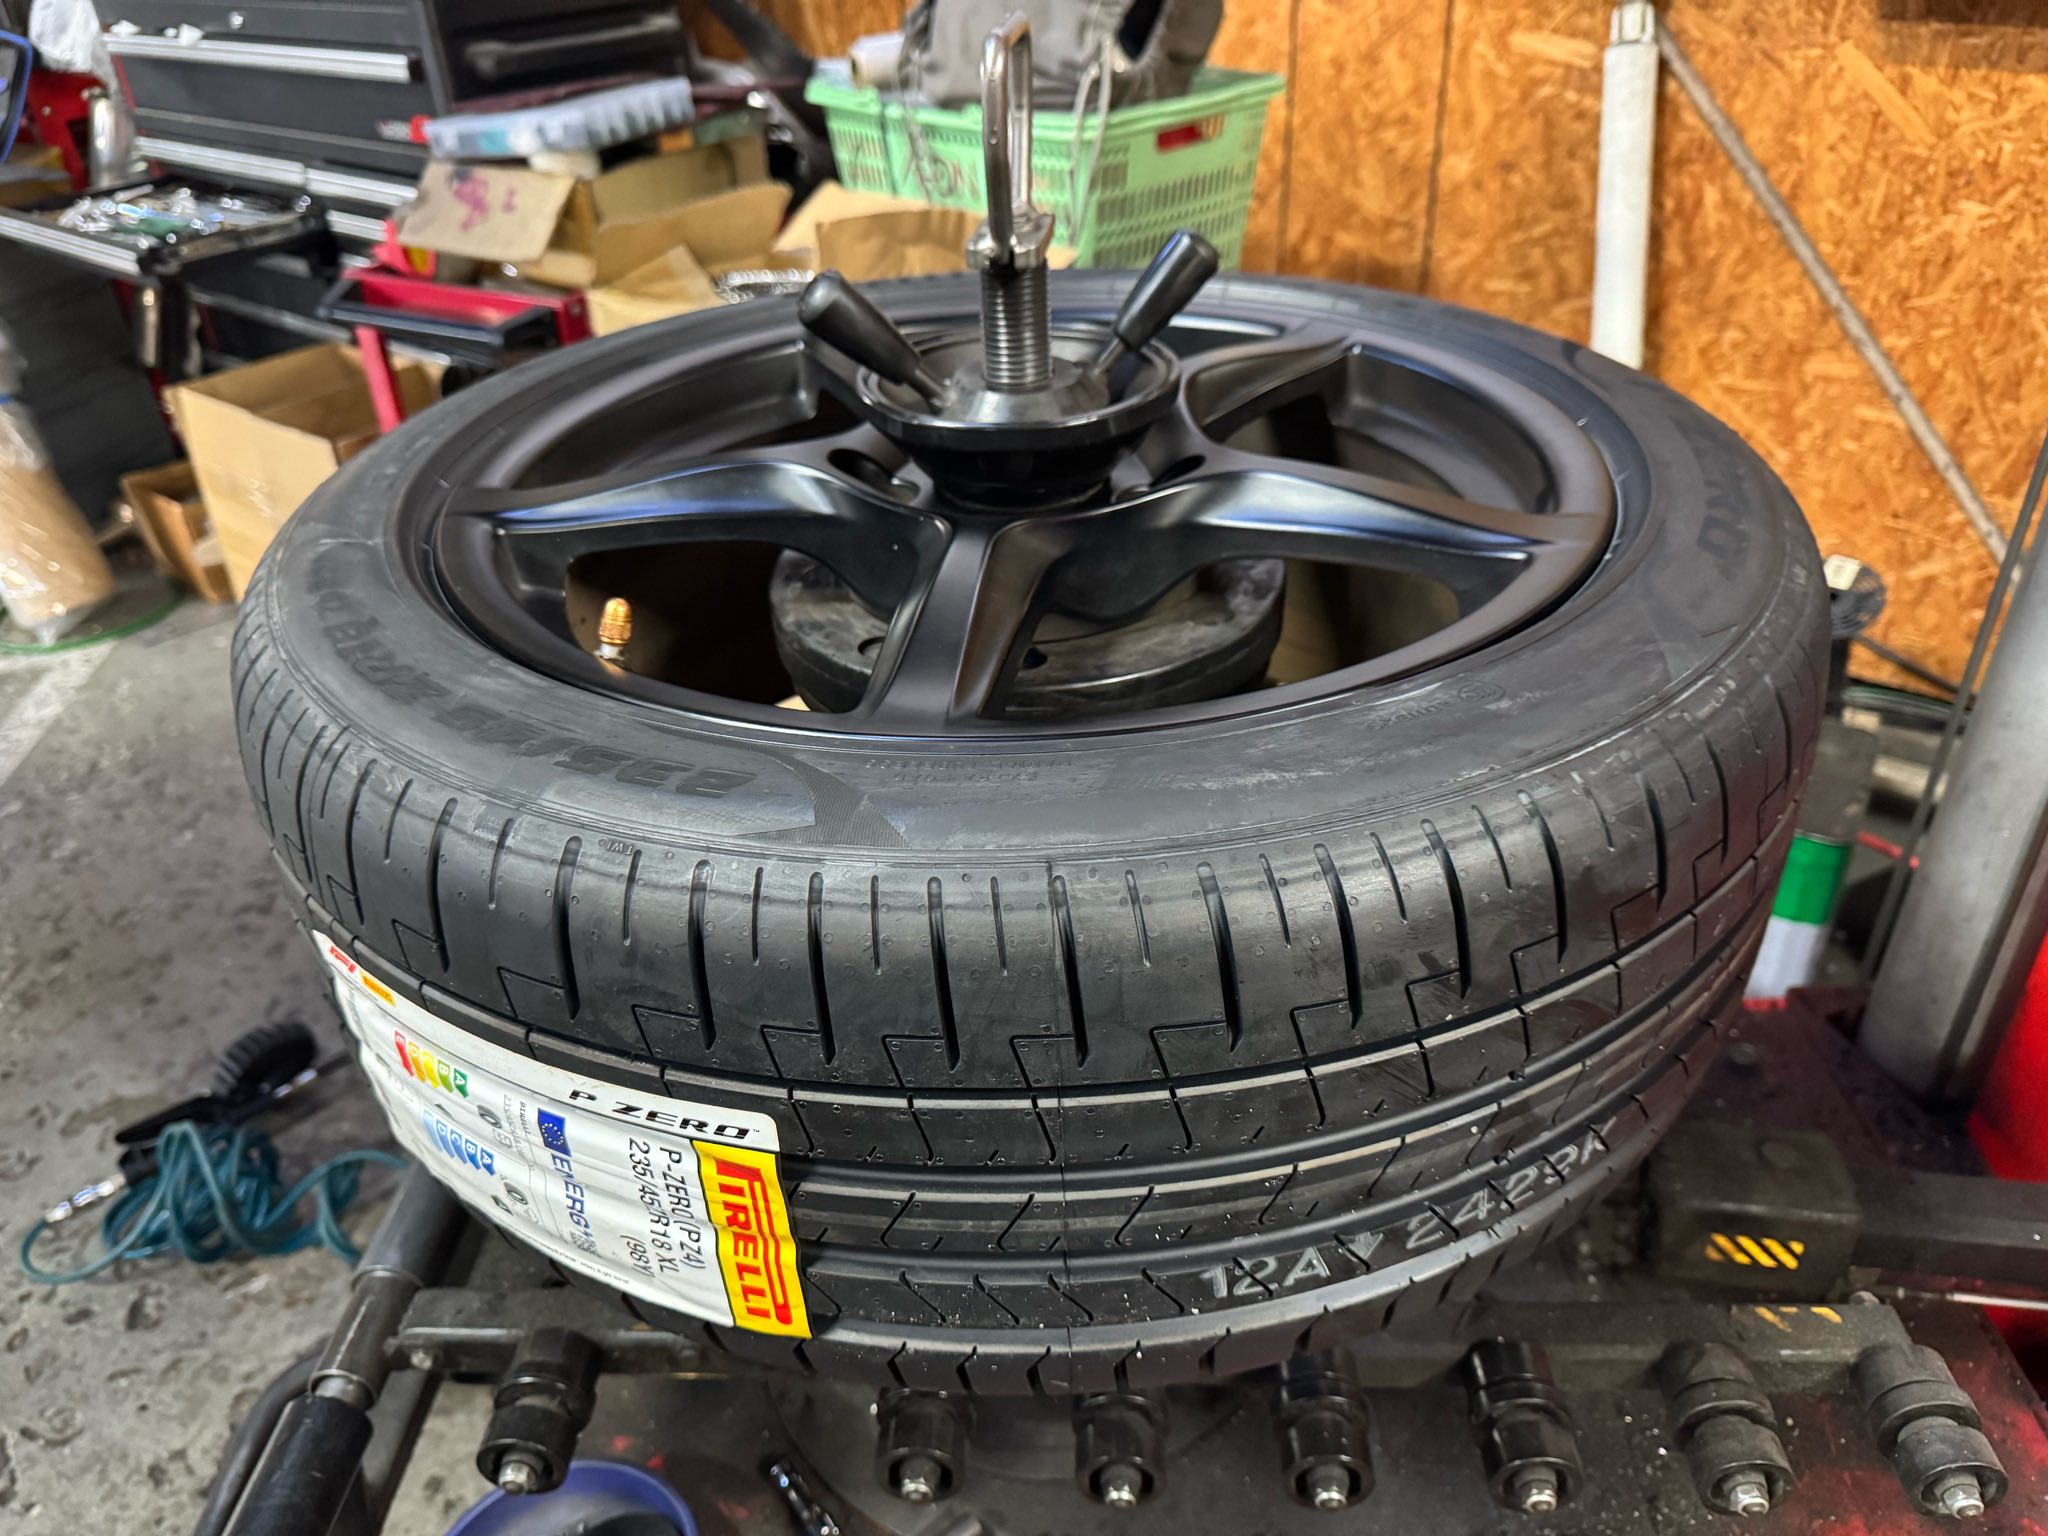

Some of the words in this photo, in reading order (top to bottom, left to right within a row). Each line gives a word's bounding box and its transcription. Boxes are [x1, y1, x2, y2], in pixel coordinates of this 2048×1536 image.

[606, 840, 633, 856] TWI
[568, 1089, 598, 1102] P
[713, 1157, 793, 1325] PIRELLI
[655, 1252, 680, 1273] XL
